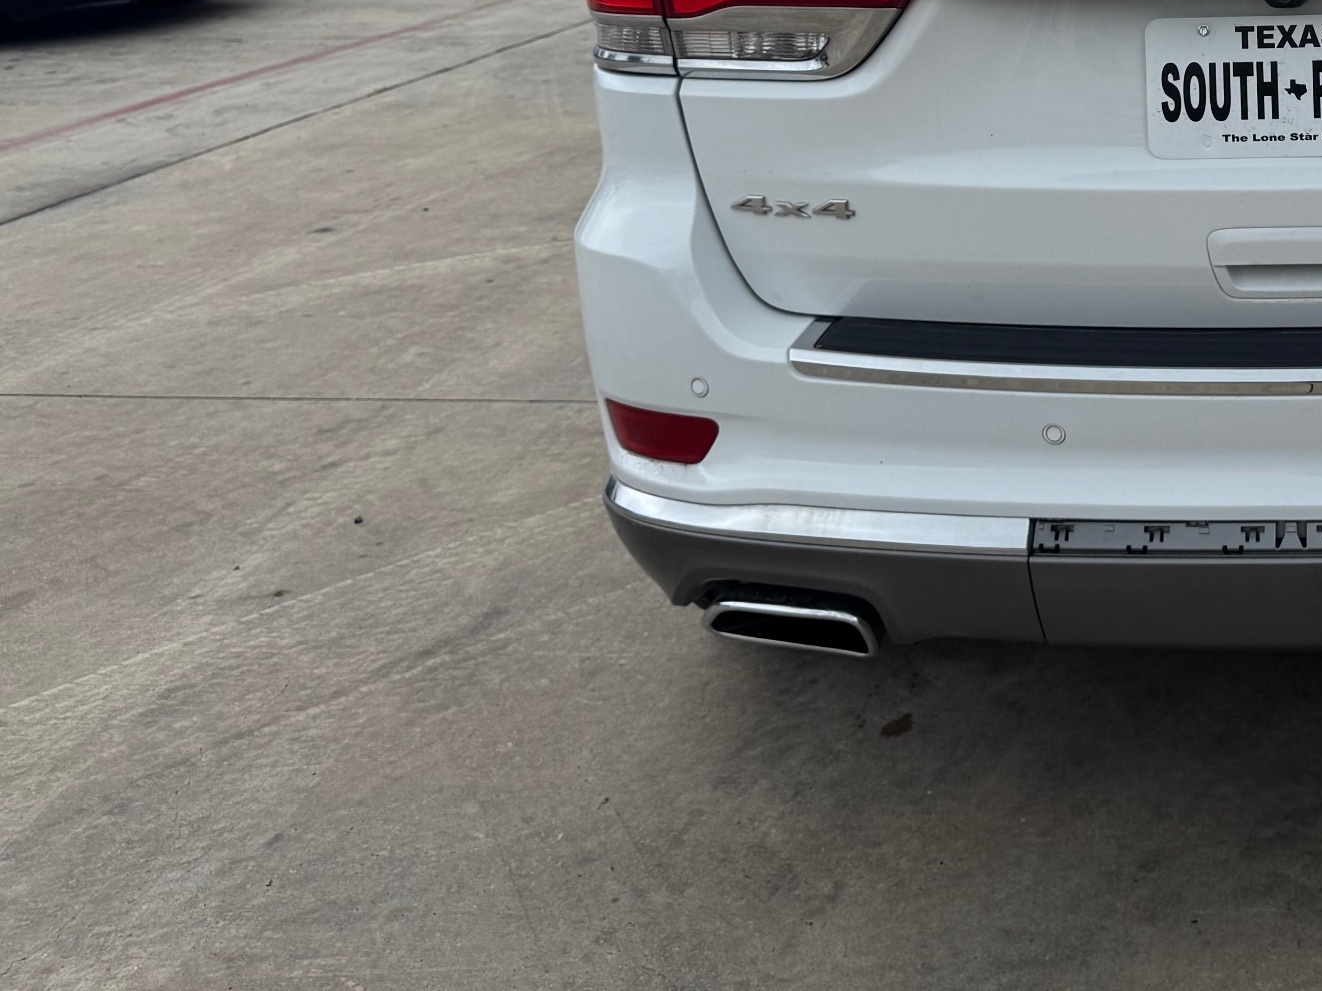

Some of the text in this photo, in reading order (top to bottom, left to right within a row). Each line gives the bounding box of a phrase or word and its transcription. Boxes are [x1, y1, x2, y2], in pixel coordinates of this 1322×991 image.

[1160, 61, 1281, 123] SOUTH
[1222, 133, 1249, 143] The
[1252, 133, 1287, 142] Lone
[1289, 131, 1319, 142] Star
